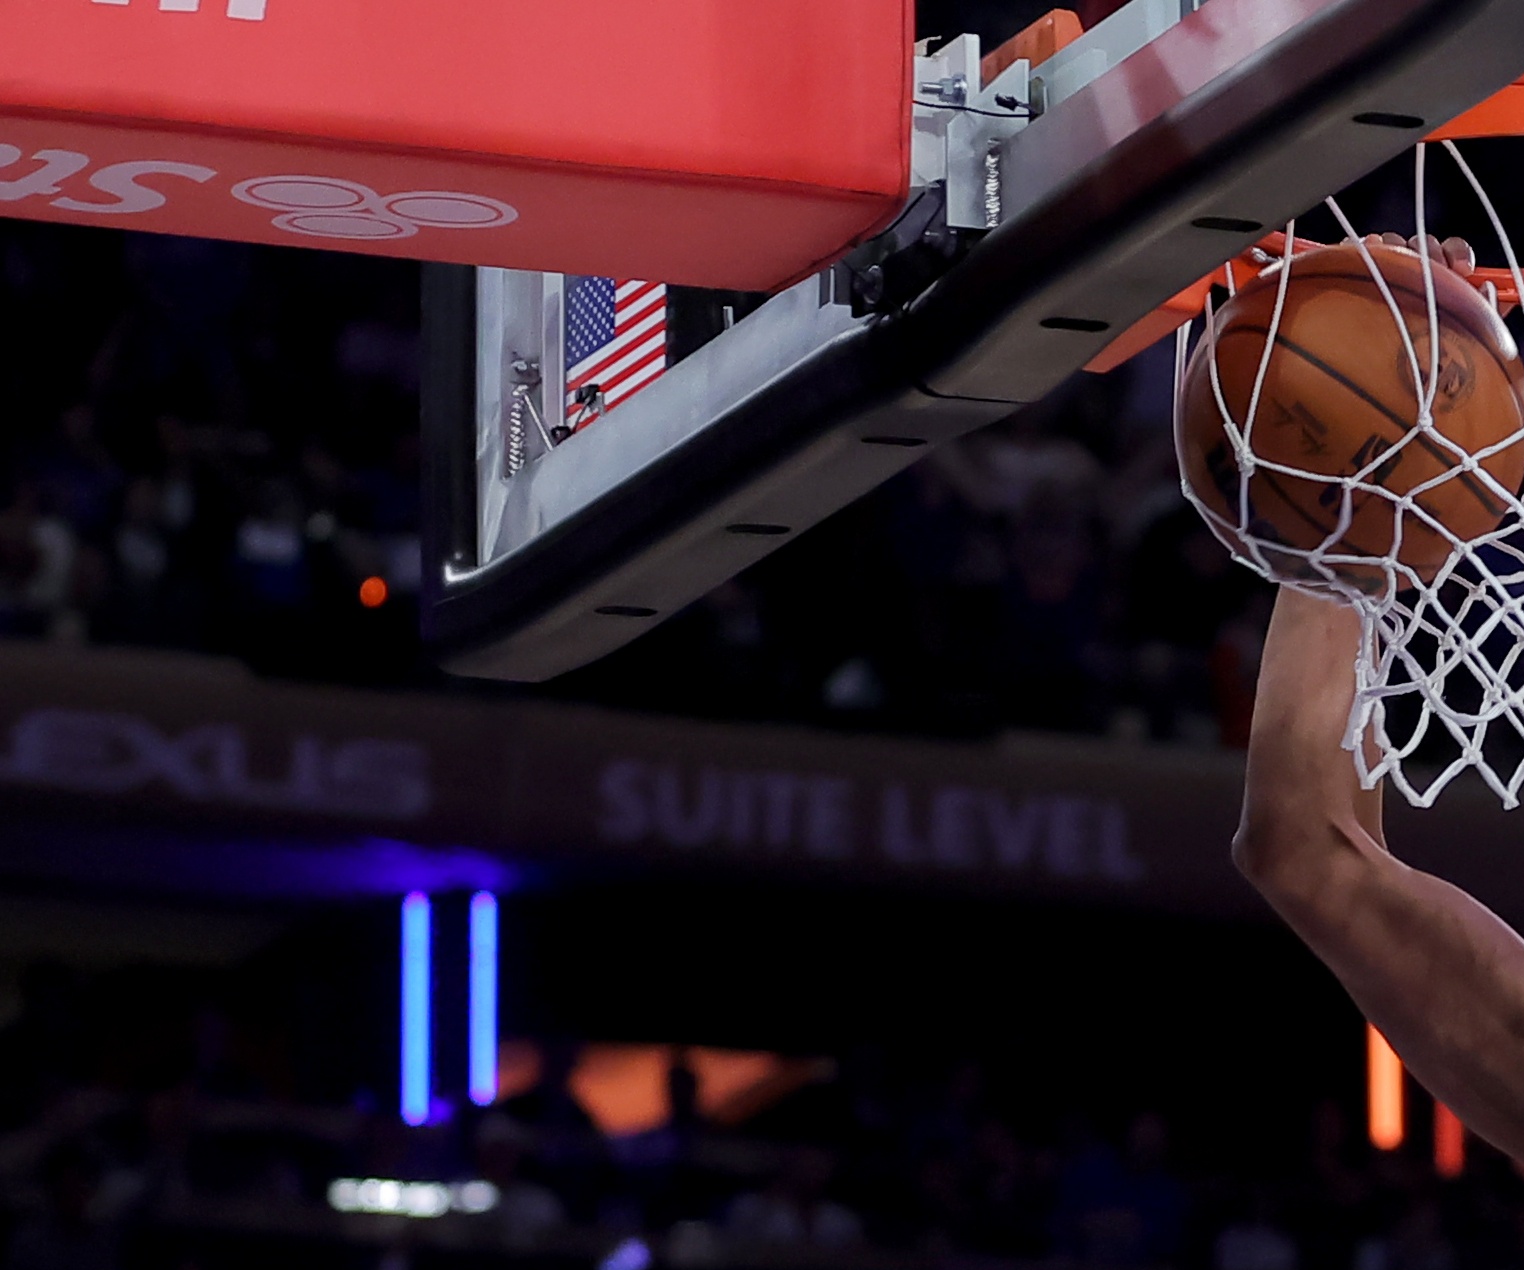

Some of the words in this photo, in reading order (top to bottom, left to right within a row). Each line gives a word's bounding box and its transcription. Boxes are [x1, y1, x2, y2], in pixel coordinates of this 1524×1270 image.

[0, 709, 431, 819] EXUS
[599, 758, 854, 858] SUITE
[880, 784, 1145, 882] LEVEL
